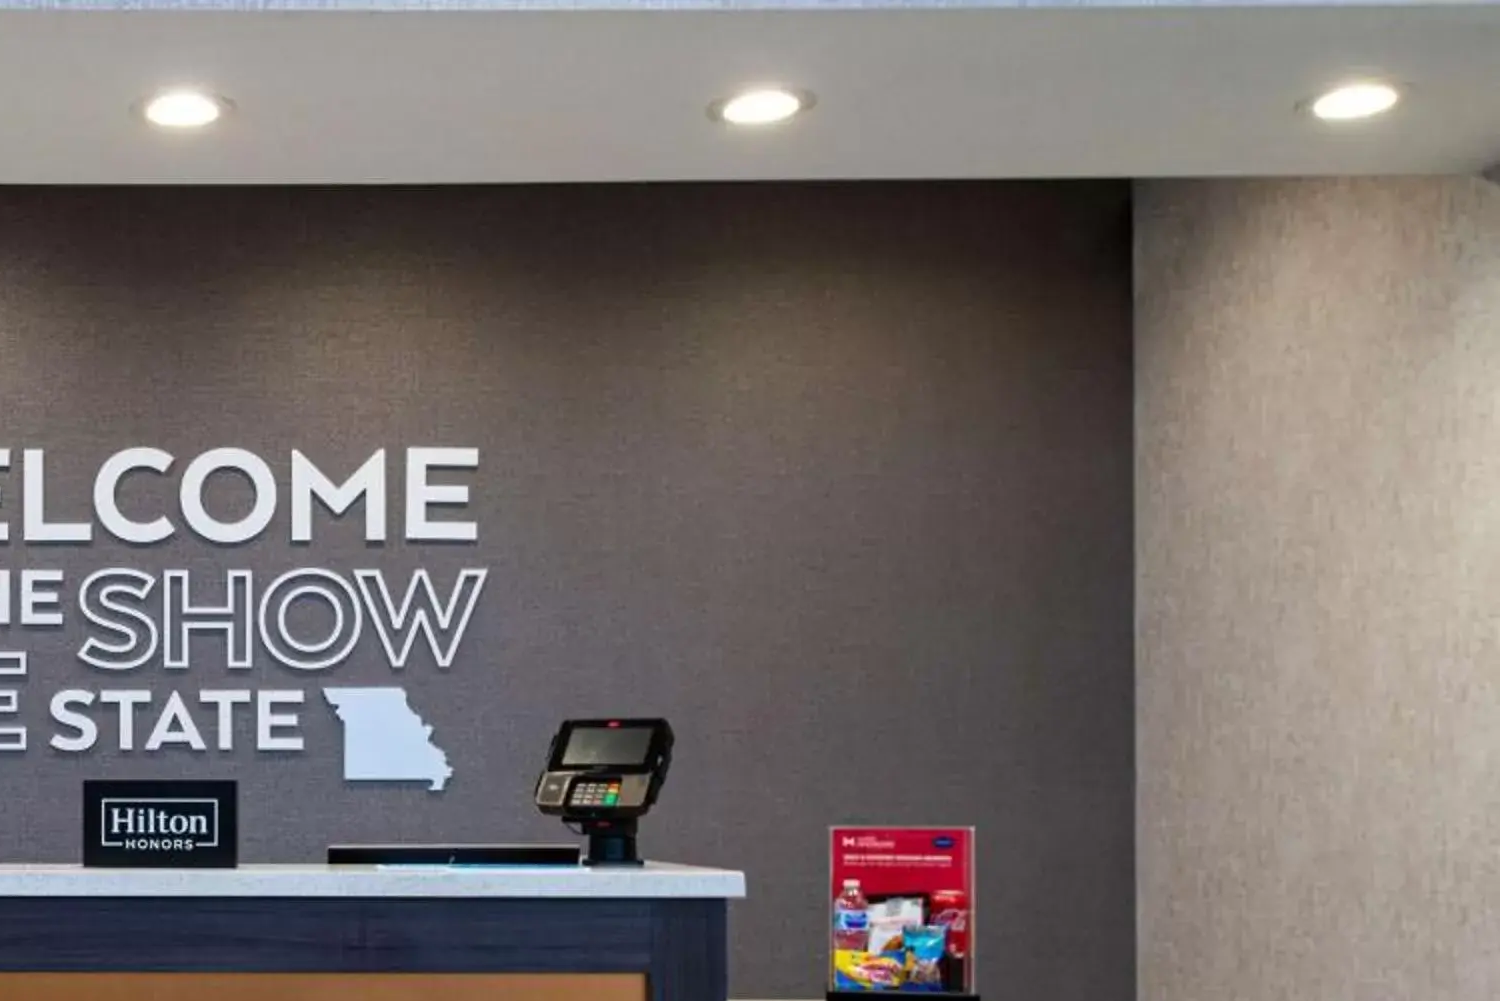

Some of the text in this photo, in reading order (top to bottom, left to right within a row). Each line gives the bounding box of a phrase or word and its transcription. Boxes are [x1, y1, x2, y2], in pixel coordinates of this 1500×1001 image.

[77, 567, 488, 670] SHOW
[50, 688, 305, 751] STATE
[110, 806, 209, 835] Hilton
[125, 838, 194, 851] HONORS
